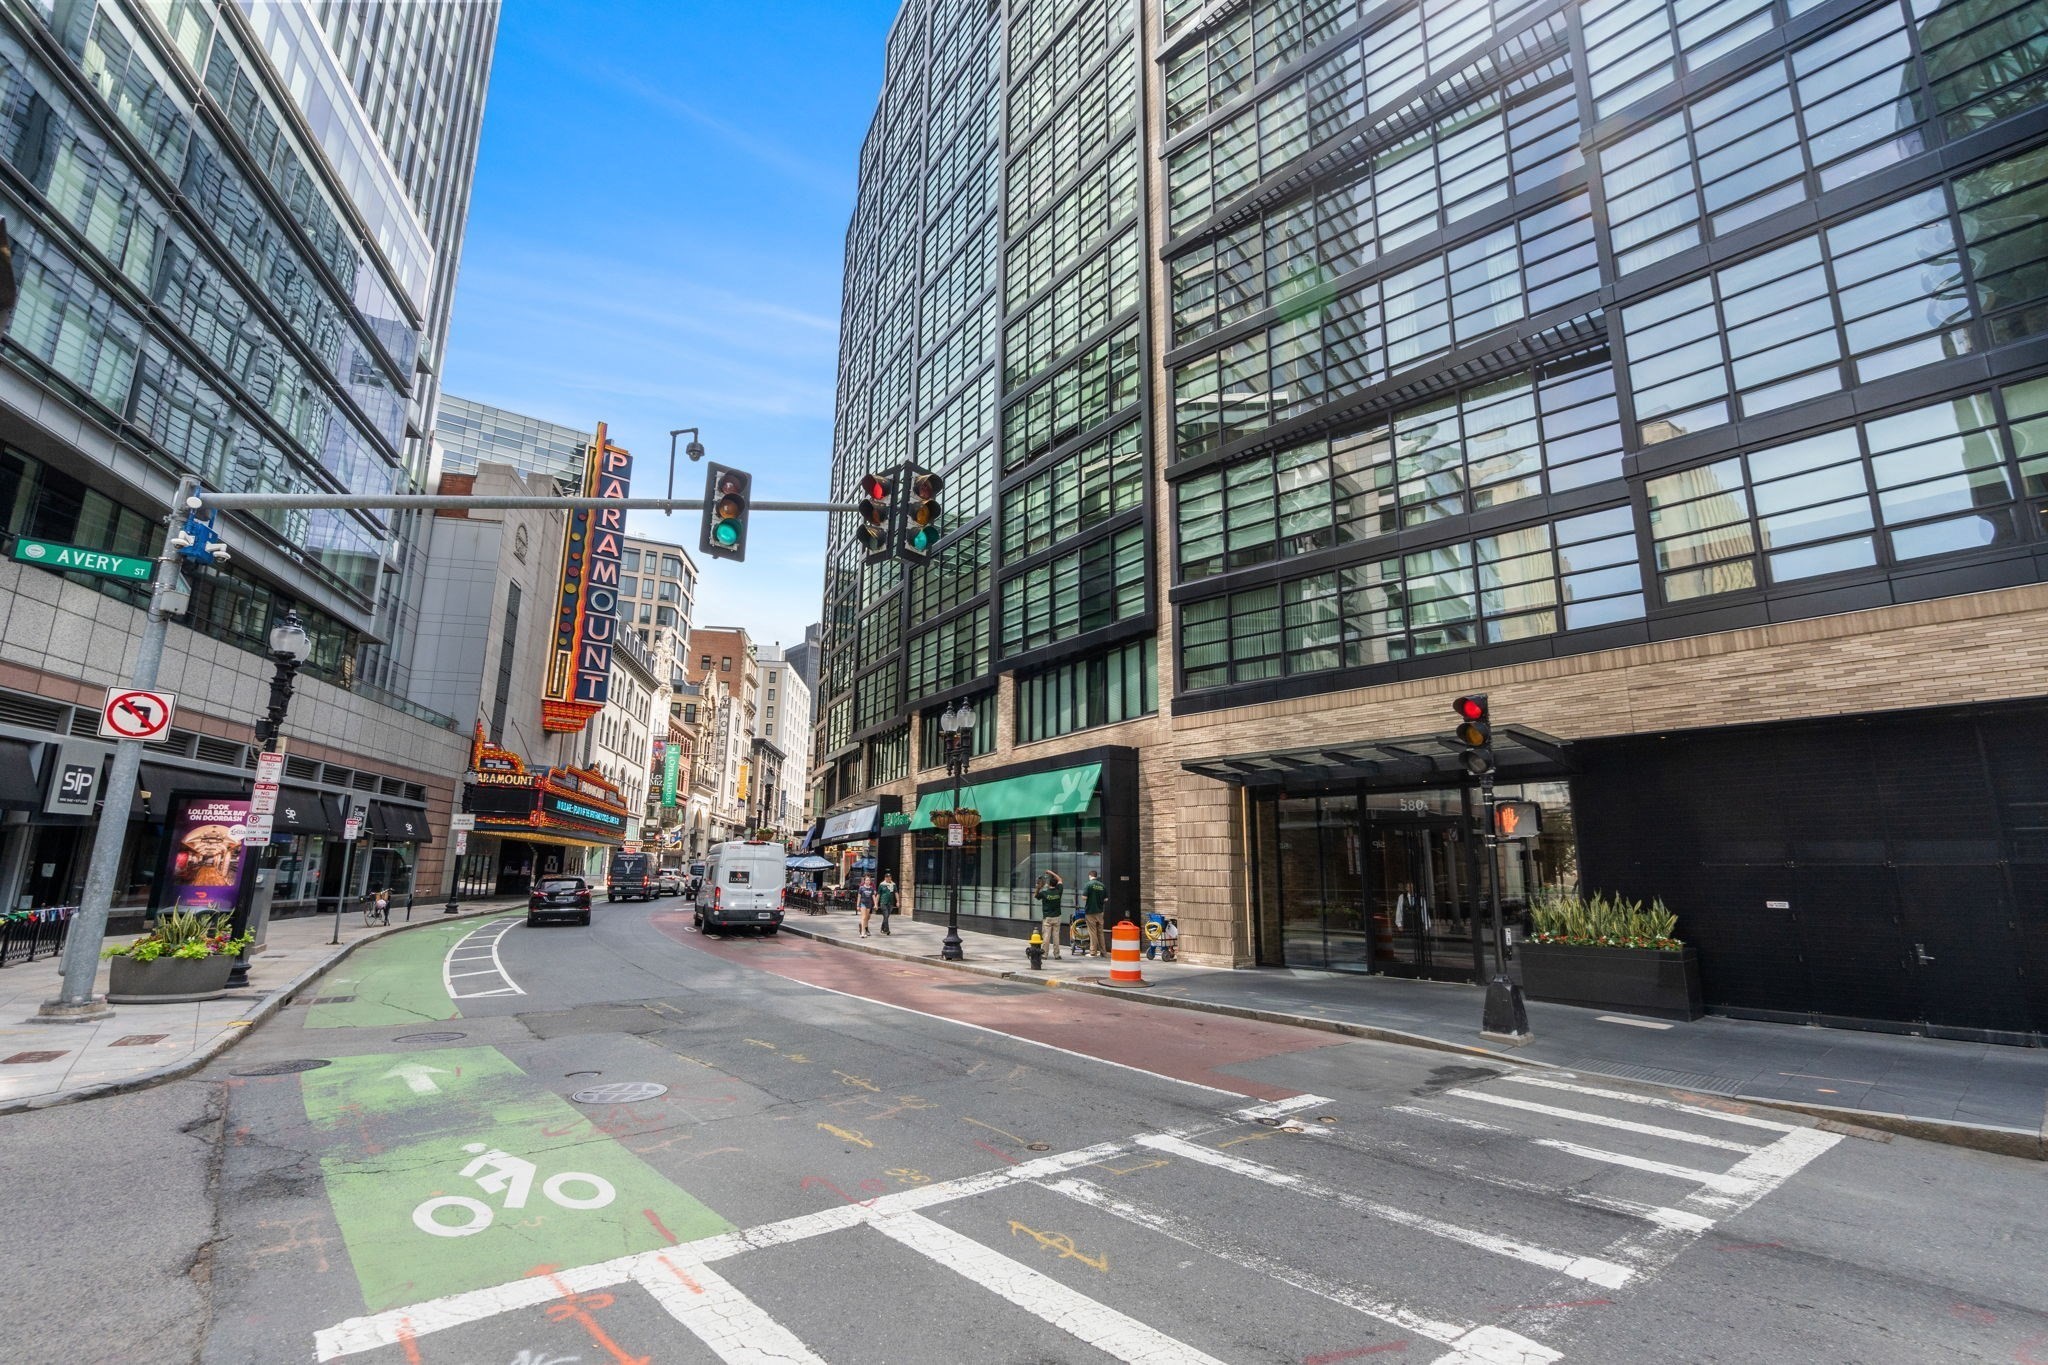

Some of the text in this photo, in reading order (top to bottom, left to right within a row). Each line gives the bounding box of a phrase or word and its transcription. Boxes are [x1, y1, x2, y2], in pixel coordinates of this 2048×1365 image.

[57, 549, 146, 576] AVERY ST
[584, 451, 628, 699] PARAMOUNT
[478, 772, 535, 786] ARAMOUNT
